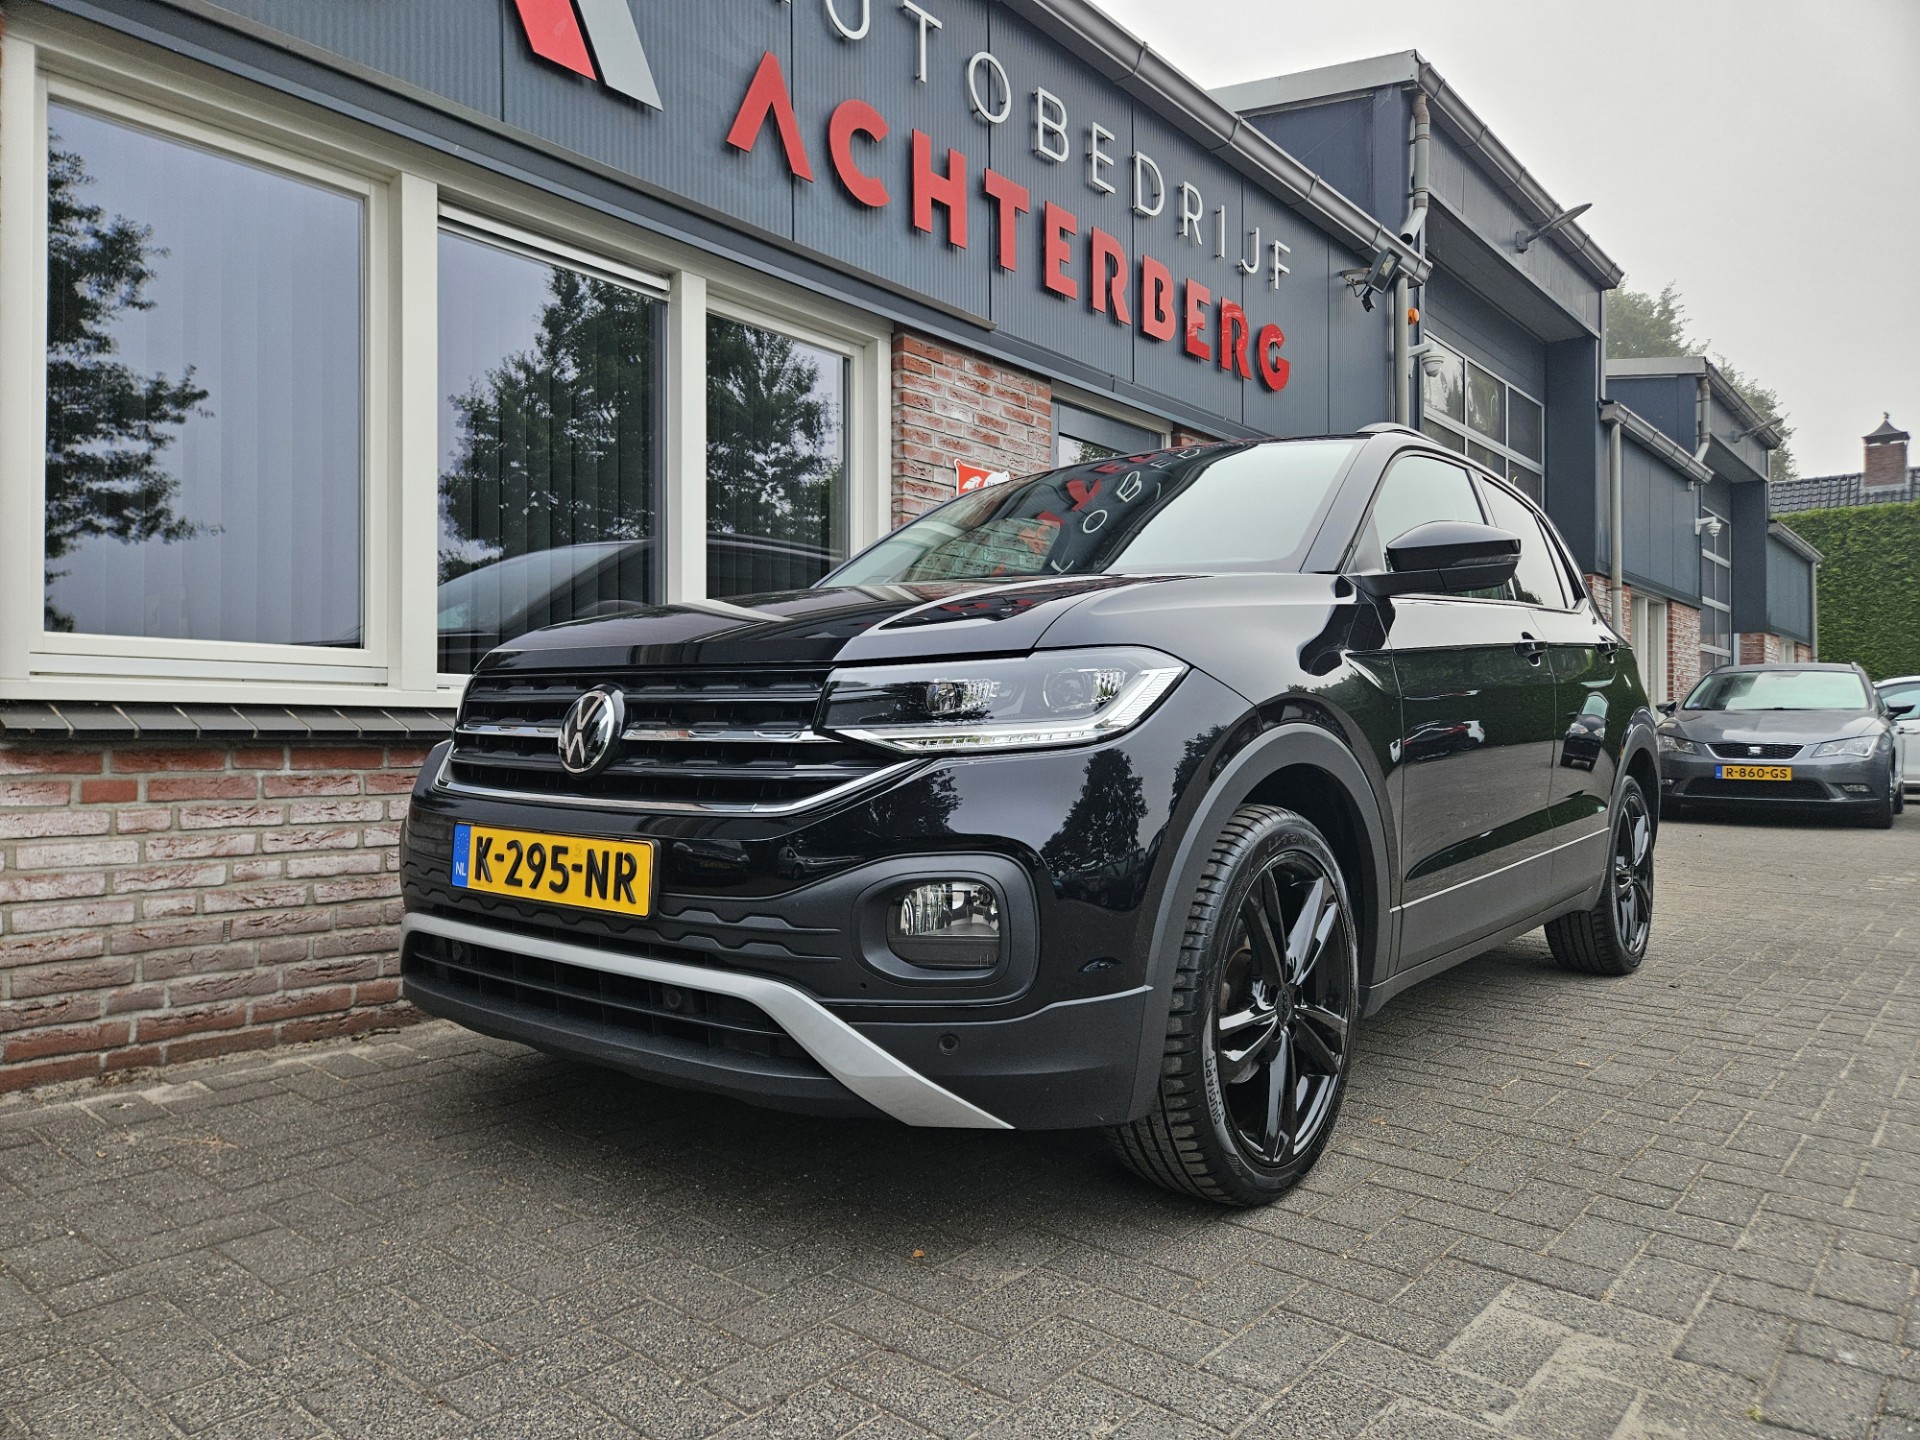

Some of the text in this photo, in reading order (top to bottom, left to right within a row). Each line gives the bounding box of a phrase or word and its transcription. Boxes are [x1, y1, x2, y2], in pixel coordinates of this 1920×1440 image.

[780, 0, 1291, 290] UTOBEDRIJF
[726, 51, 1290, 392] ACHTERBERG
[1726, 768, 1787, 778] R-860-GS
[455, 861, 467, 877] NL
[474, 836, 637, 904] K-295-NR
